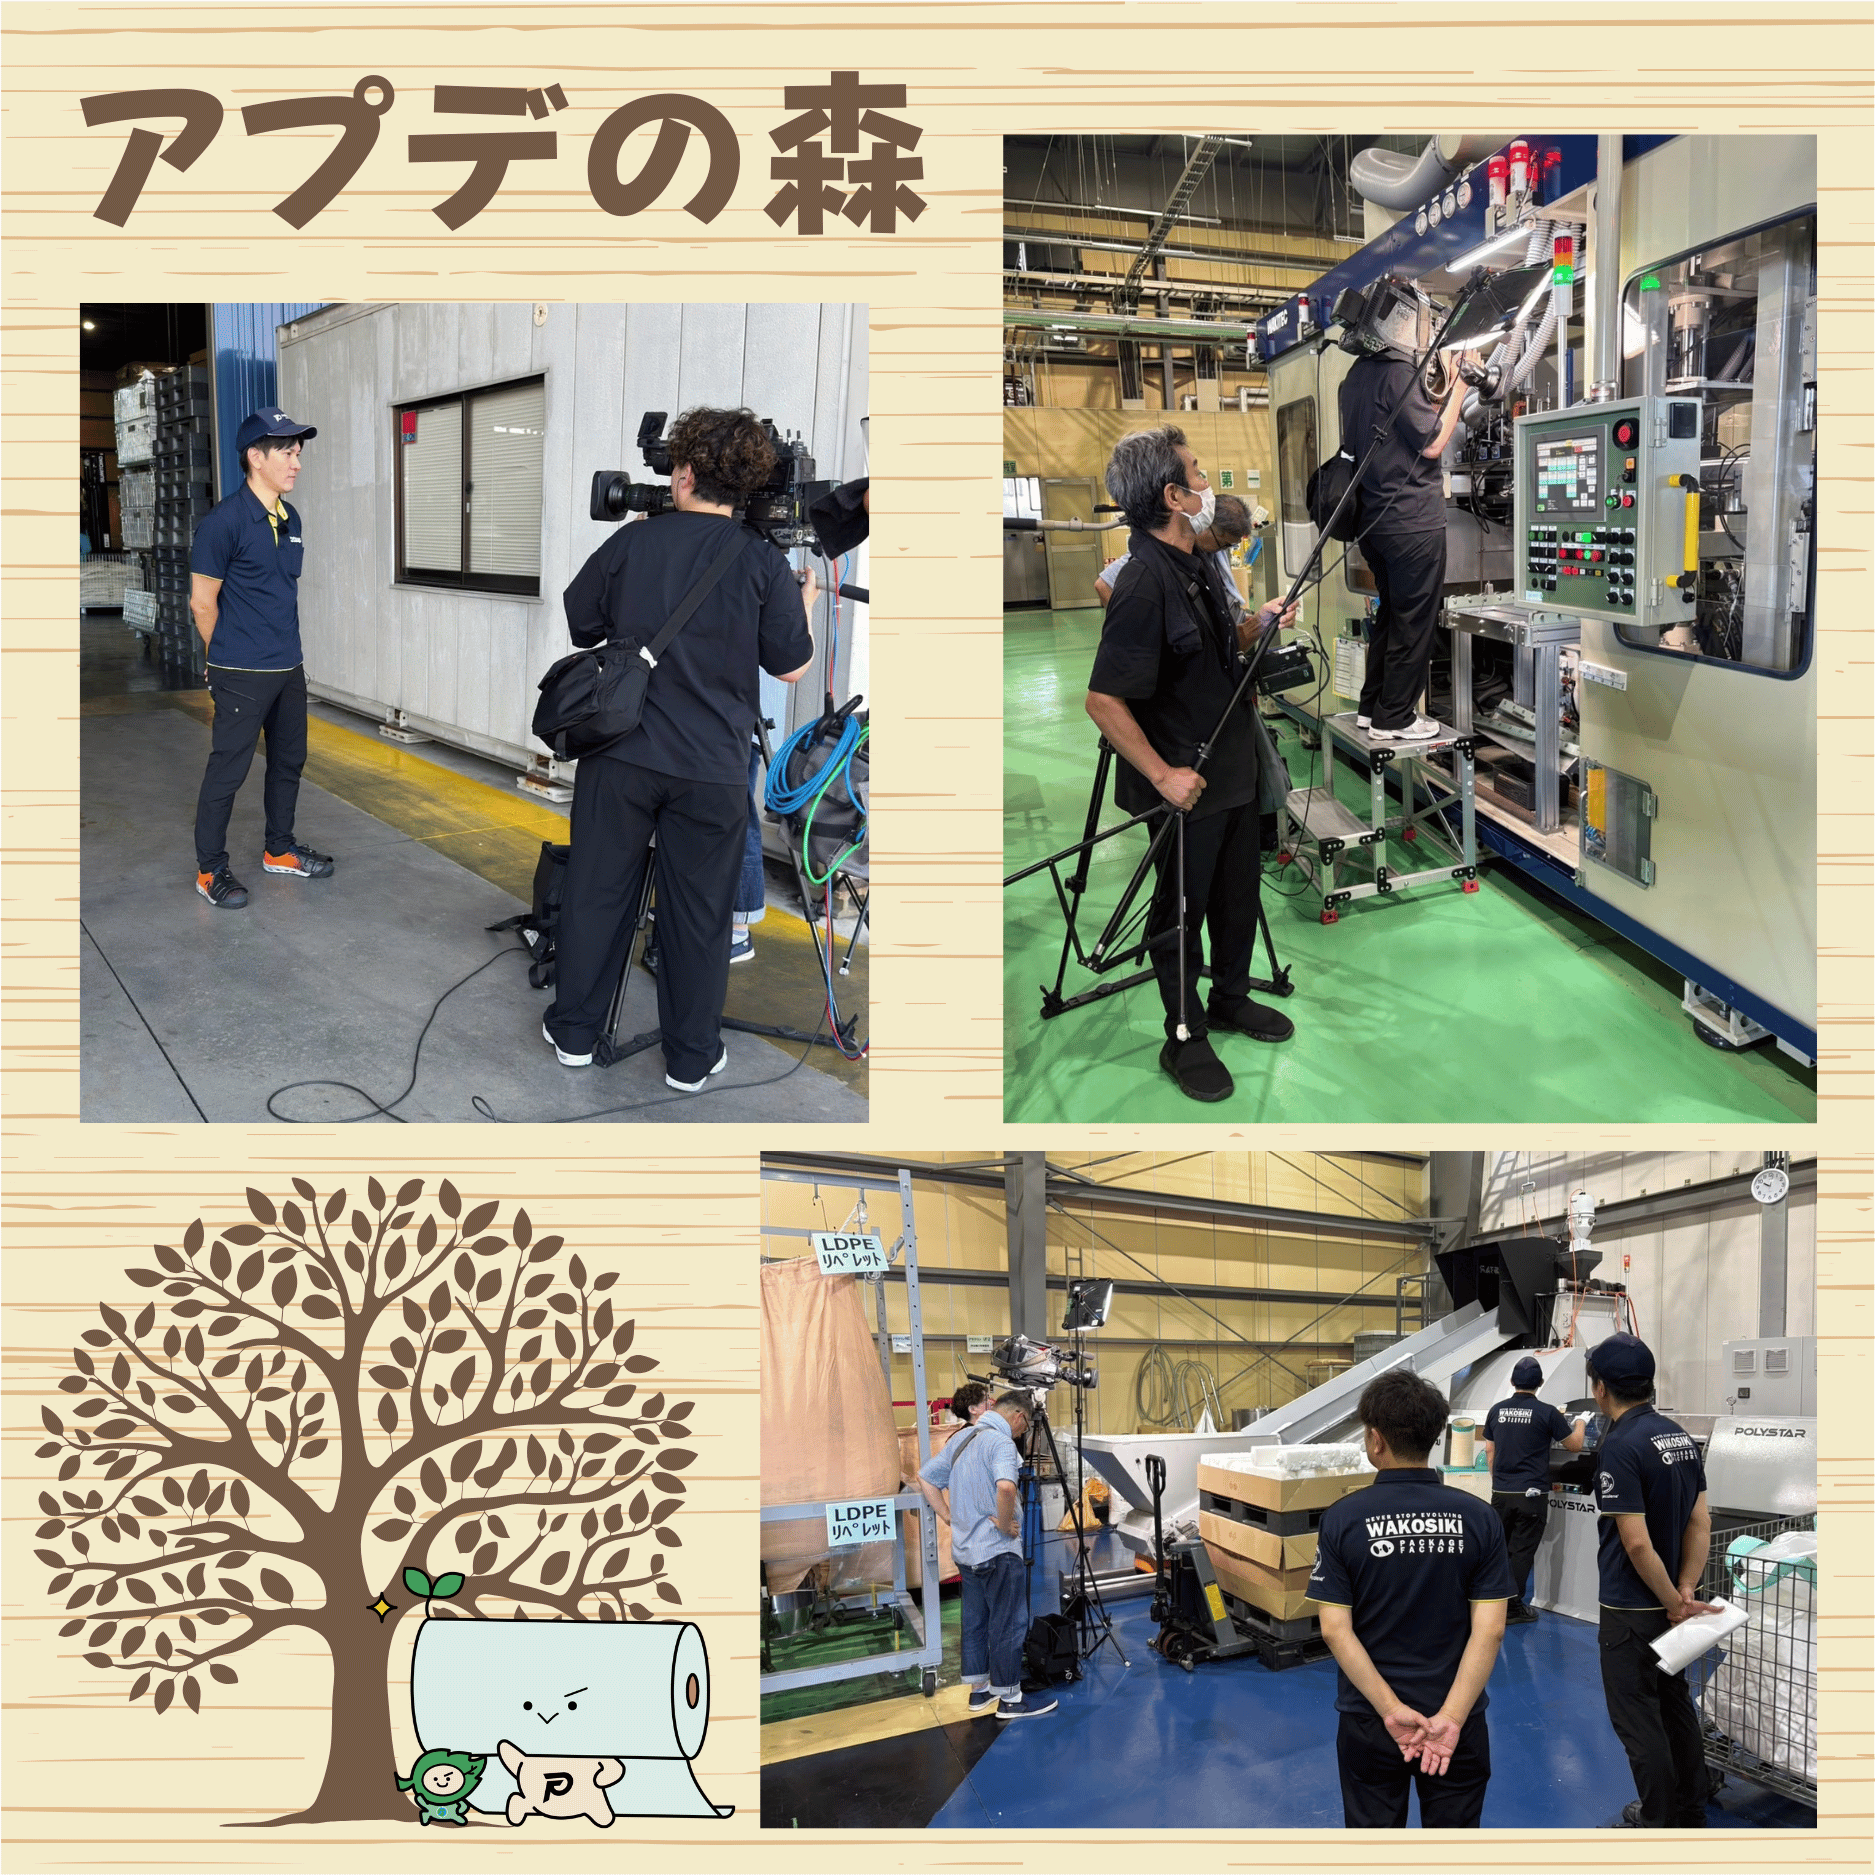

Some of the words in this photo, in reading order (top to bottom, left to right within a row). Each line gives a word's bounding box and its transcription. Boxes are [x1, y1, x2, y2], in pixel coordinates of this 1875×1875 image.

[822, 1238, 875, 1251] LDPE
[1499, 1409, 1533, 1417] WAKOSIKI
[1734, 1427, 1806, 1438] POLYSTAR
[1547, 1499, 1595, 1514] OLYSTAR
[835, 1504, 887, 1522] LDPE
[1365, 1514, 1391, 1523] NEVER
[1421, 1512, 1462, 1520] EVOLVING
[1366, 1518, 1463, 1538] WAKOSIKI
[1400, 1539, 1464, 1547] PACKAGE
[1400, 1546, 1464, 1554] FACTORY
